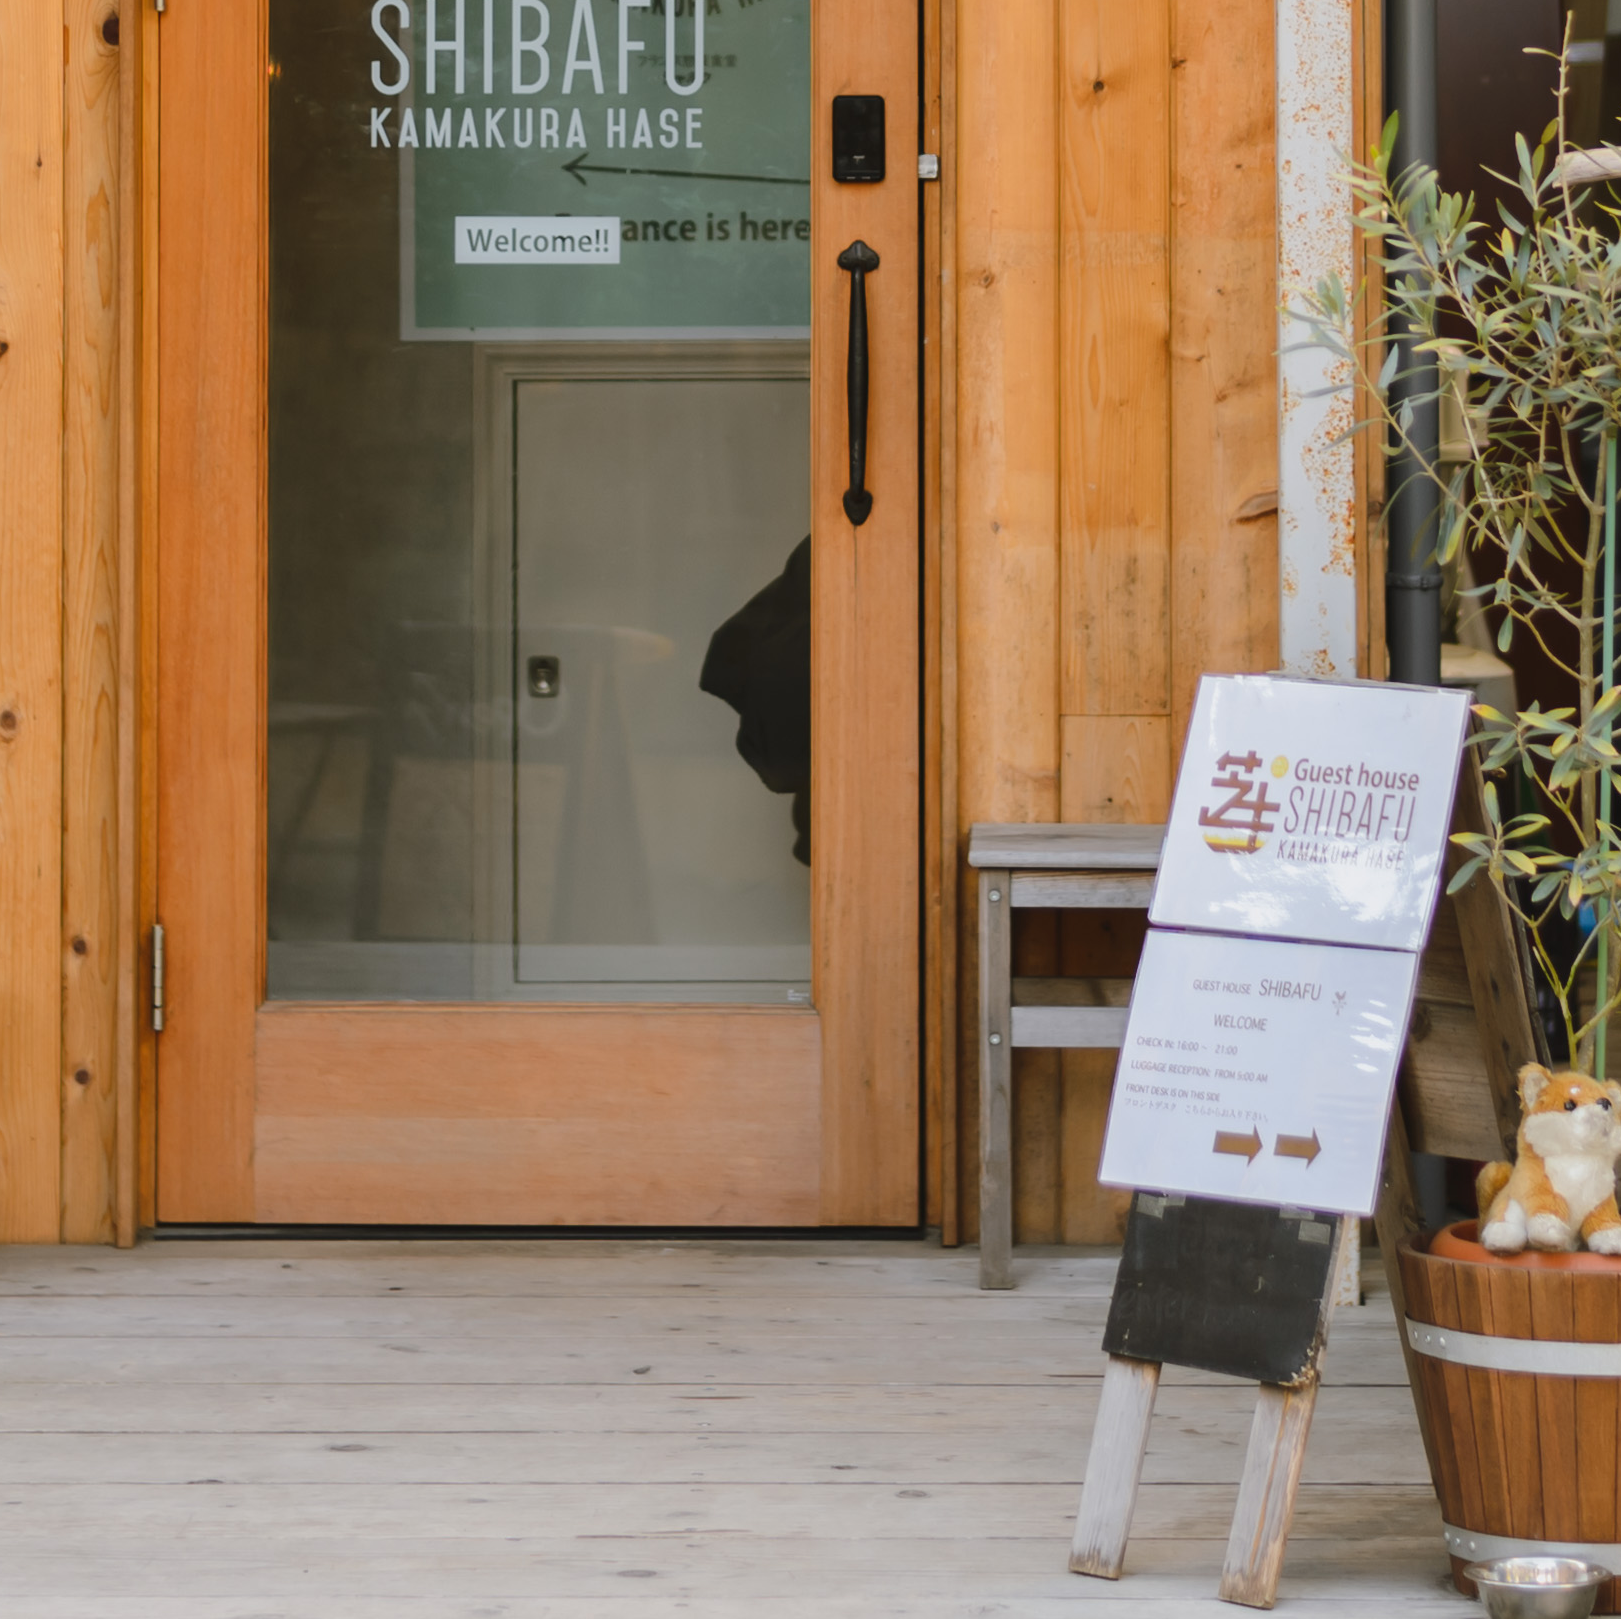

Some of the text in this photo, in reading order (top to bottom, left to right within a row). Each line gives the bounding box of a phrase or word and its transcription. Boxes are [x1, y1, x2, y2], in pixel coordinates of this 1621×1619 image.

[370, 107, 704, 149] KAMAKURA HASE
[705, 212, 730, 241] is
[466, 228, 610, 253] Welcome!!
[1294, 758, 1420, 792] Guest house
[1283, 785, 1416, 843] SHIBAFU
[1277, 839, 1360, 867] KAMAKURA
[1193, 979, 1322, 1001] GUEST HOUSE SHIBAFU
[1213, 1014, 1268, 1031] WELCOME
[1136, 1036, 1163, 1048] CHECK
[1214, 1044, 1238, 1056] 21:00
[1131, 1060, 1167, 1073] LUGGAGE
[1214, 1068, 1236, 1080] FROM
[1255, 1073, 1268, 1083] AM
[1126, 1083, 1150, 1095] FRONT
[1151, 1086, 1169, 1097] DESK
[1178, 1090, 1189, 1099] ON
[1190, 1091, 1205, 1101] THIS
[1206, 1093, 1221, 1103] SIDE
[1124, 1098, 1177, 1113] フロントデスク
